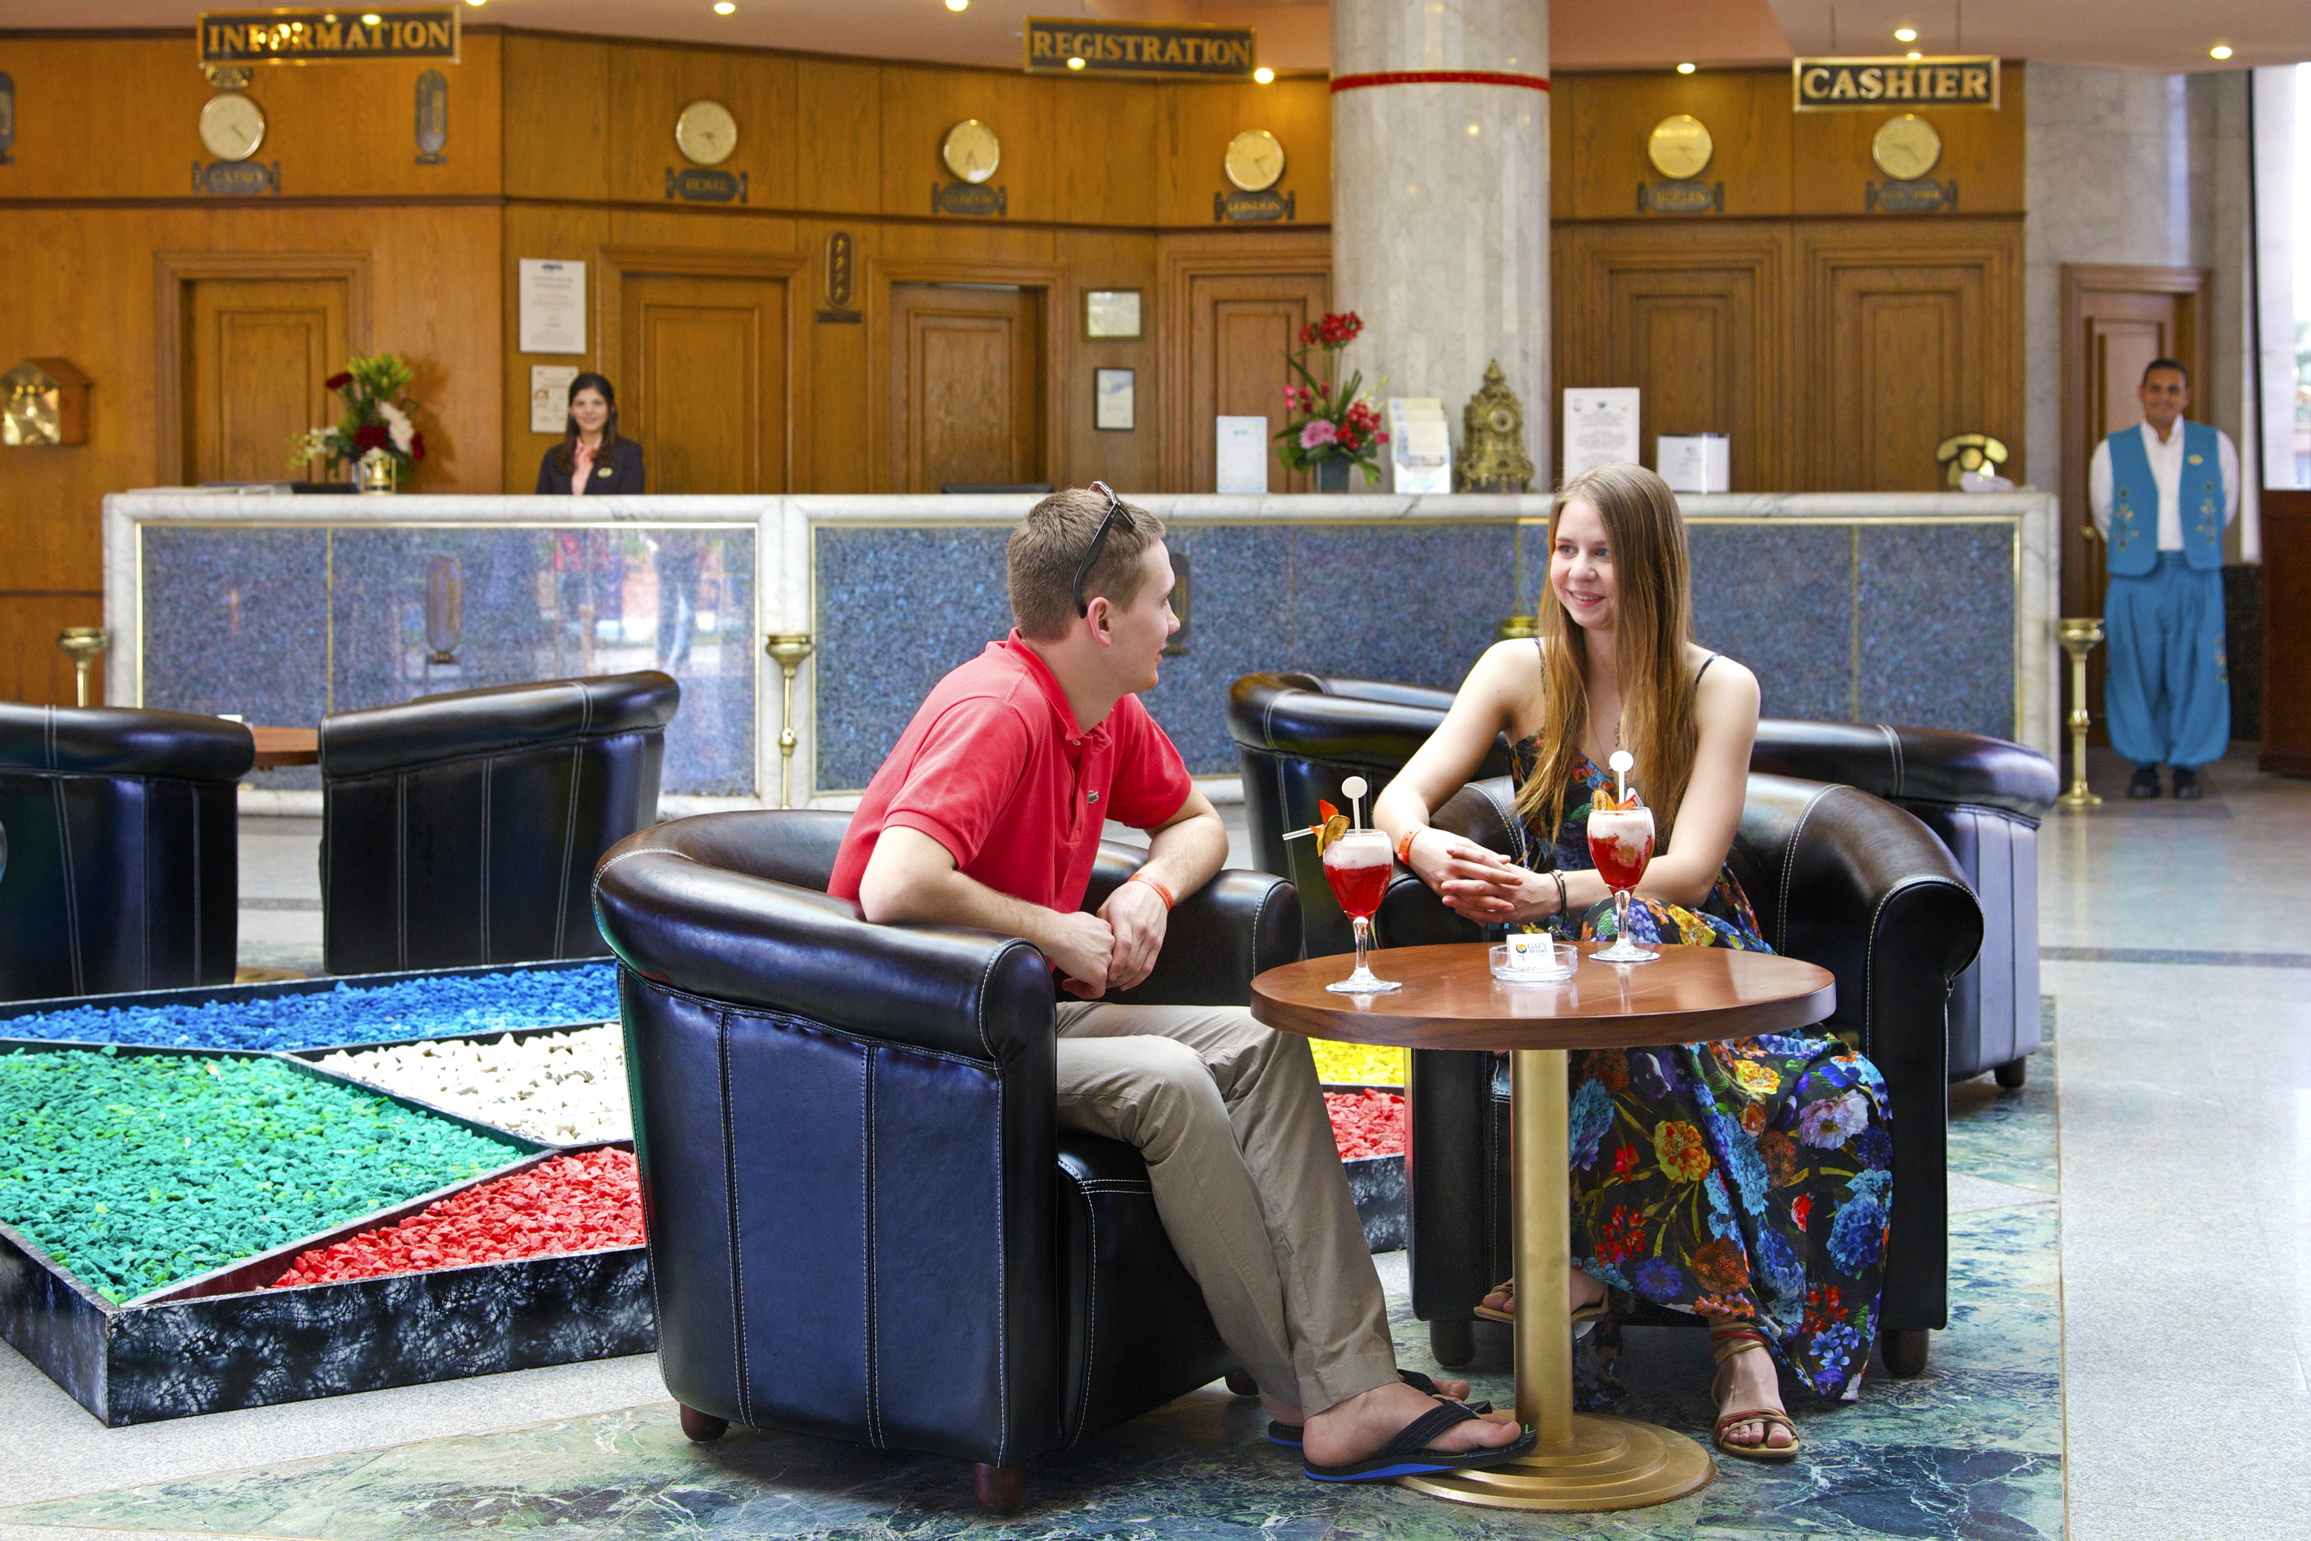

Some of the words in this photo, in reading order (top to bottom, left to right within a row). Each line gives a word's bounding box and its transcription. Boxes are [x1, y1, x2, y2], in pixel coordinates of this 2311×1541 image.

[208, 20, 450, 53] INFORMATION
[1031, 30, 1250, 65] REGISTRATION
[1802, 67, 1989, 99] CASHIER
